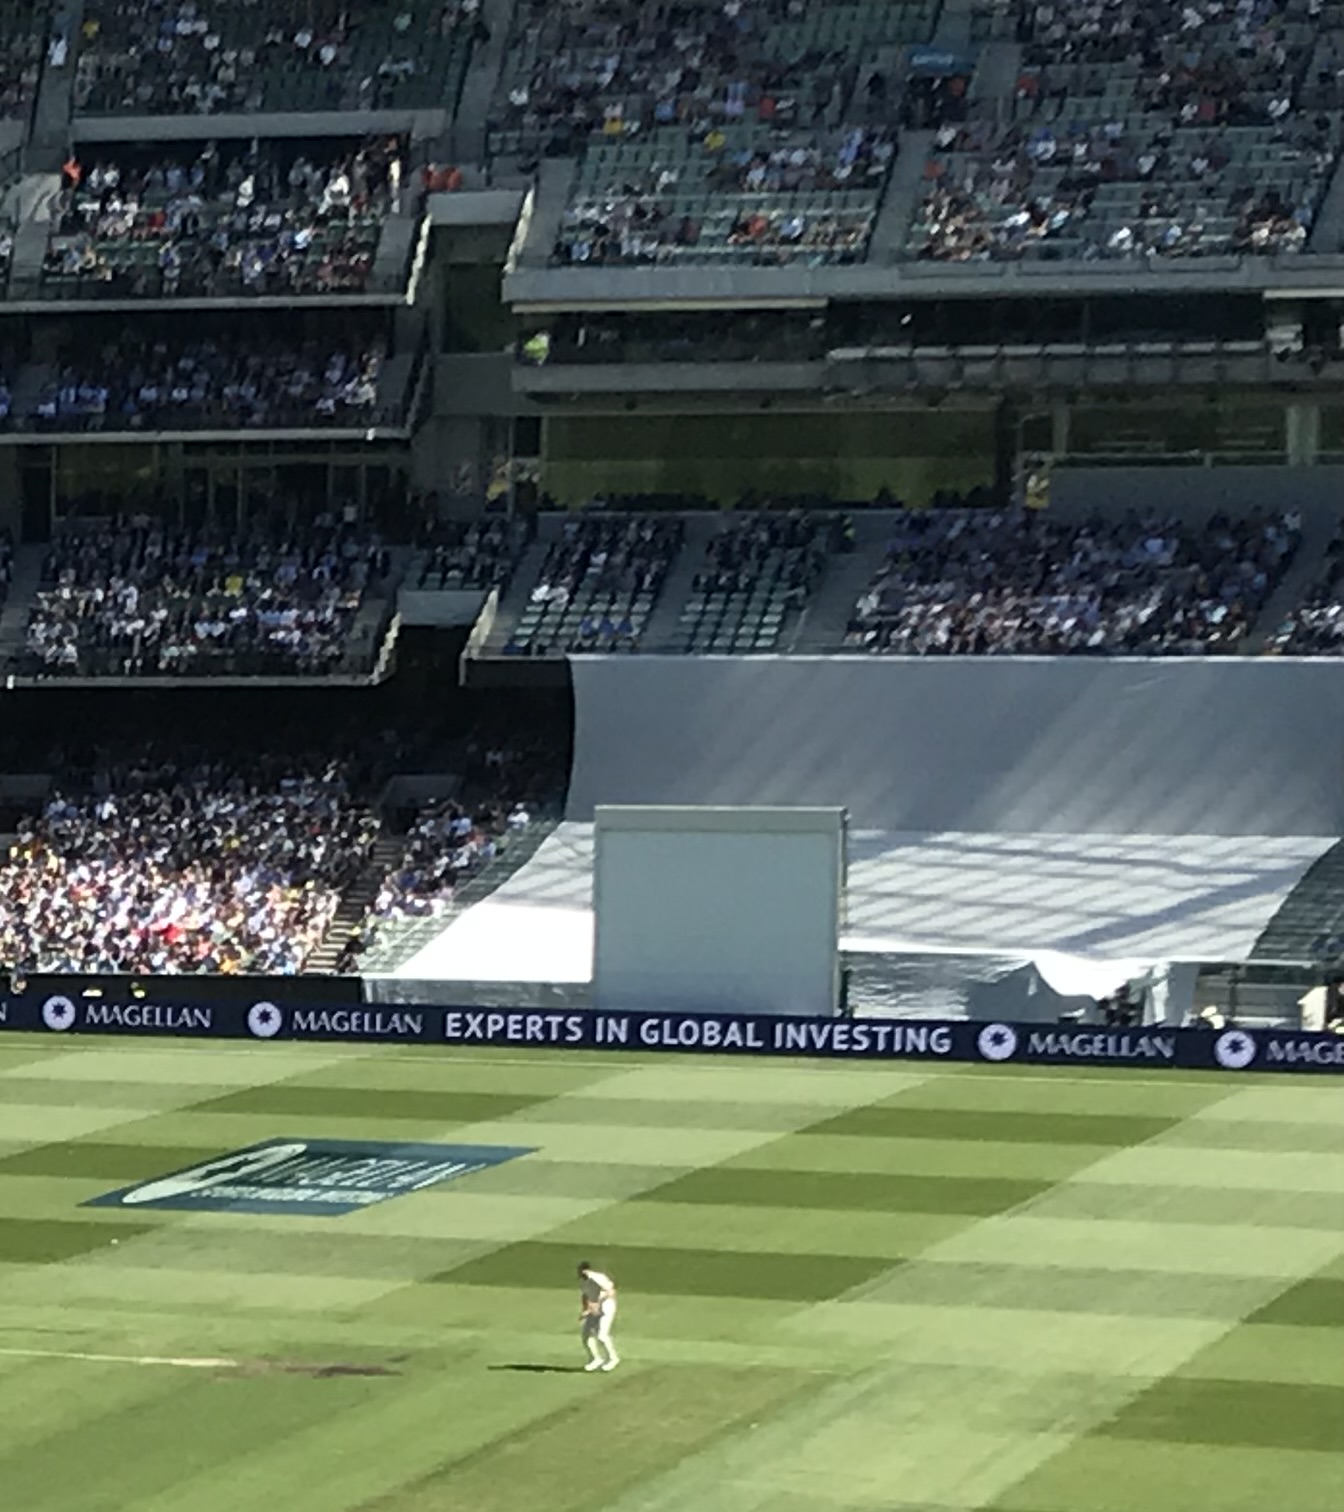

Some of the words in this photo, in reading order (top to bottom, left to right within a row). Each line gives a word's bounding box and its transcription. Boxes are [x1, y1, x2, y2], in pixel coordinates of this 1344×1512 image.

[85, 1005, 211, 1029] MAGELLAN
[292, 1010, 422, 1034] MAGELLAN
[445, 1012, 584, 1042] EXPERTS
[595, 1016, 628, 1043] IN
[639, 1017, 764, 1048] GLOBAL
[774, 1022, 952, 1054] INVESTING
[1028, 1032, 1176, 1058] MAGELLAN
